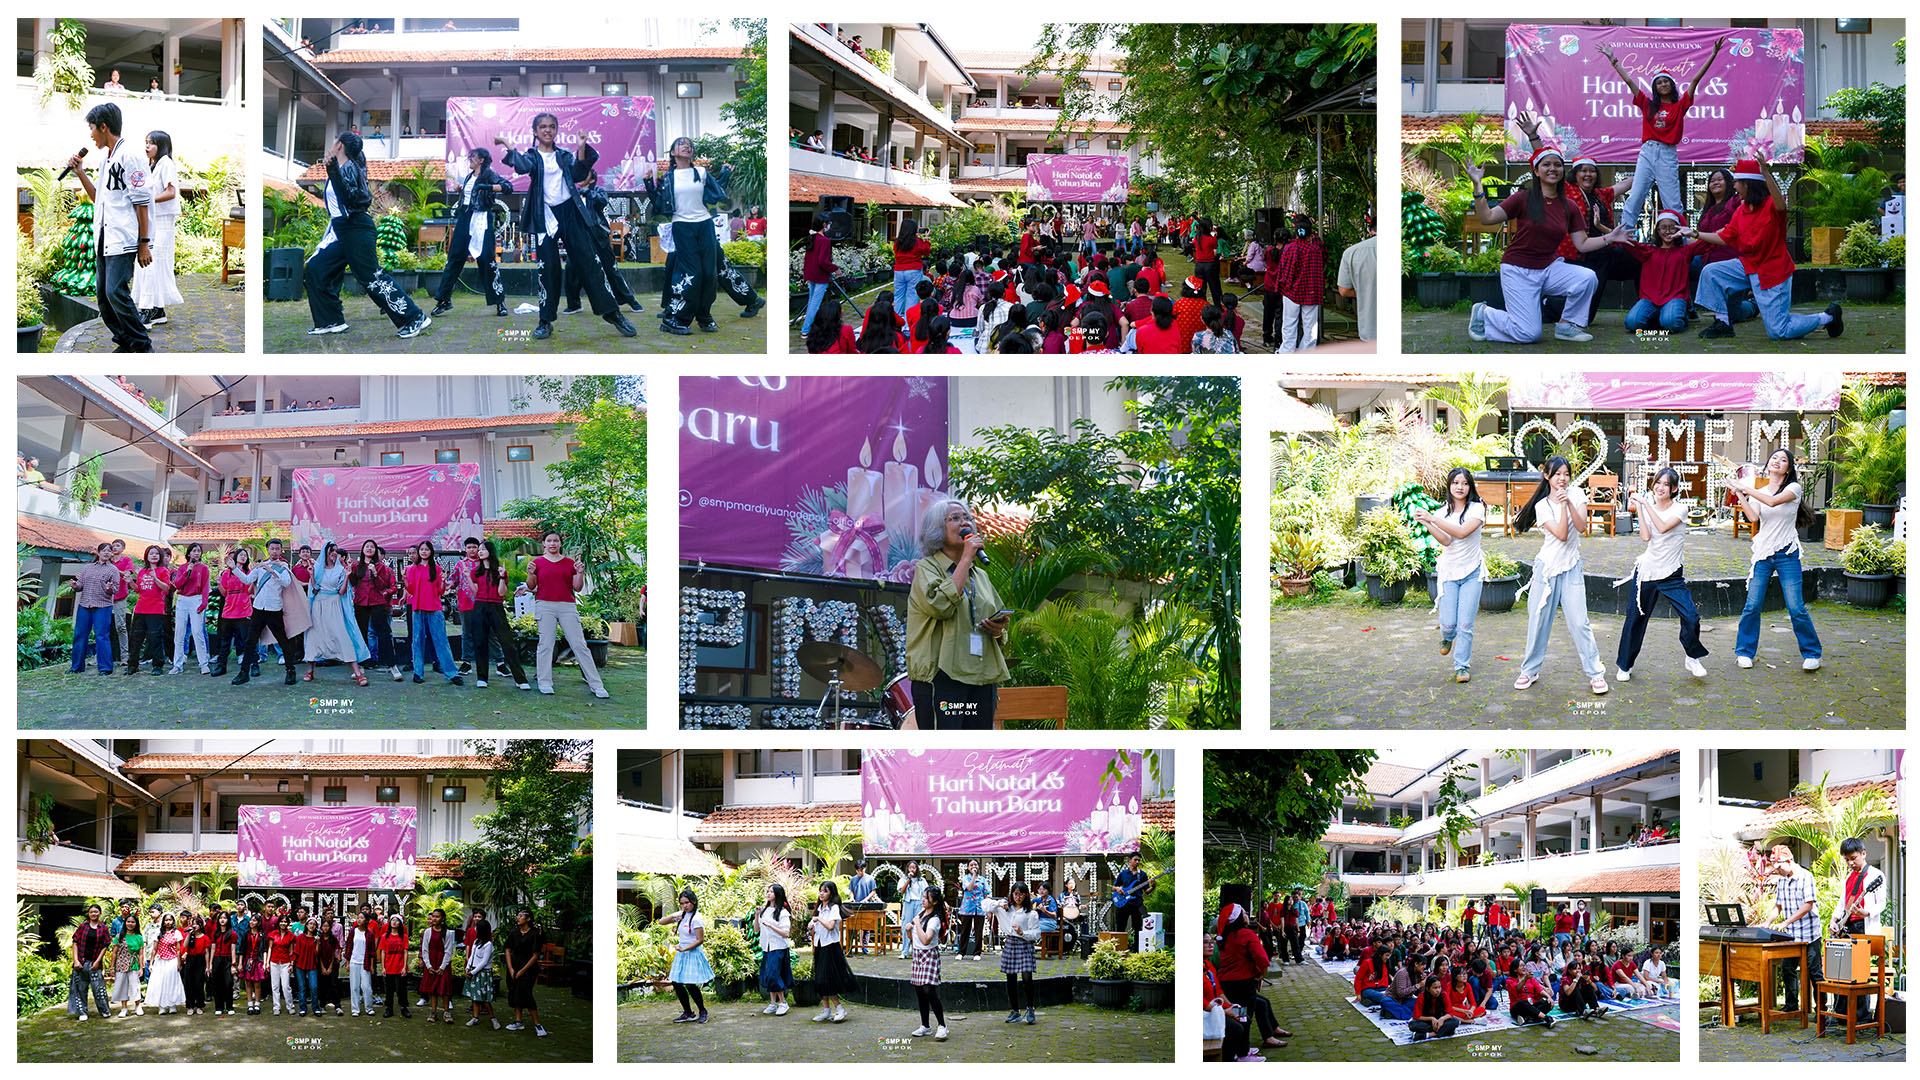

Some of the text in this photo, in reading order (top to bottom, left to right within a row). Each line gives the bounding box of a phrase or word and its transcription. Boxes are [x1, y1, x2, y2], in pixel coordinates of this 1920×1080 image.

[1728, 38, 1754, 57] 76
[1704, 76, 1729, 96] &
[601, 103, 620, 117] 76
[1585, 98, 1726, 119] Tahu aru
[587, 130, 602, 144] &
[106, 162, 127, 191] NY
[1052, 171, 1103, 180] Hari Natal &
[1053, 179, 1101, 188] Tahun Baru
[1062, 203, 1125, 218] SMP MY
[679, 405, 780, 452] aru
[1625, 418, 1830, 465] SMP MY
[428, 470, 446, 483] 76
[360, 482, 405, 497] Selamat
[336, 495, 429, 509] Hari Natal &
[338, 511, 428, 524] Tahun Baru
[963, 751, 1030, 775] Selamat
[928, 771, 1065, 793] Hari Natal &
[931, 795, 1063, 814] Tahun Baru
[370, 813, 386, 825] 76
[305, 822, 349, 837] Selamat
[282, 836, 370, 849] Hari Natal &
[284, 850, 368, 863] Tahun Baru
[300, 892, 359, 917] SMP
